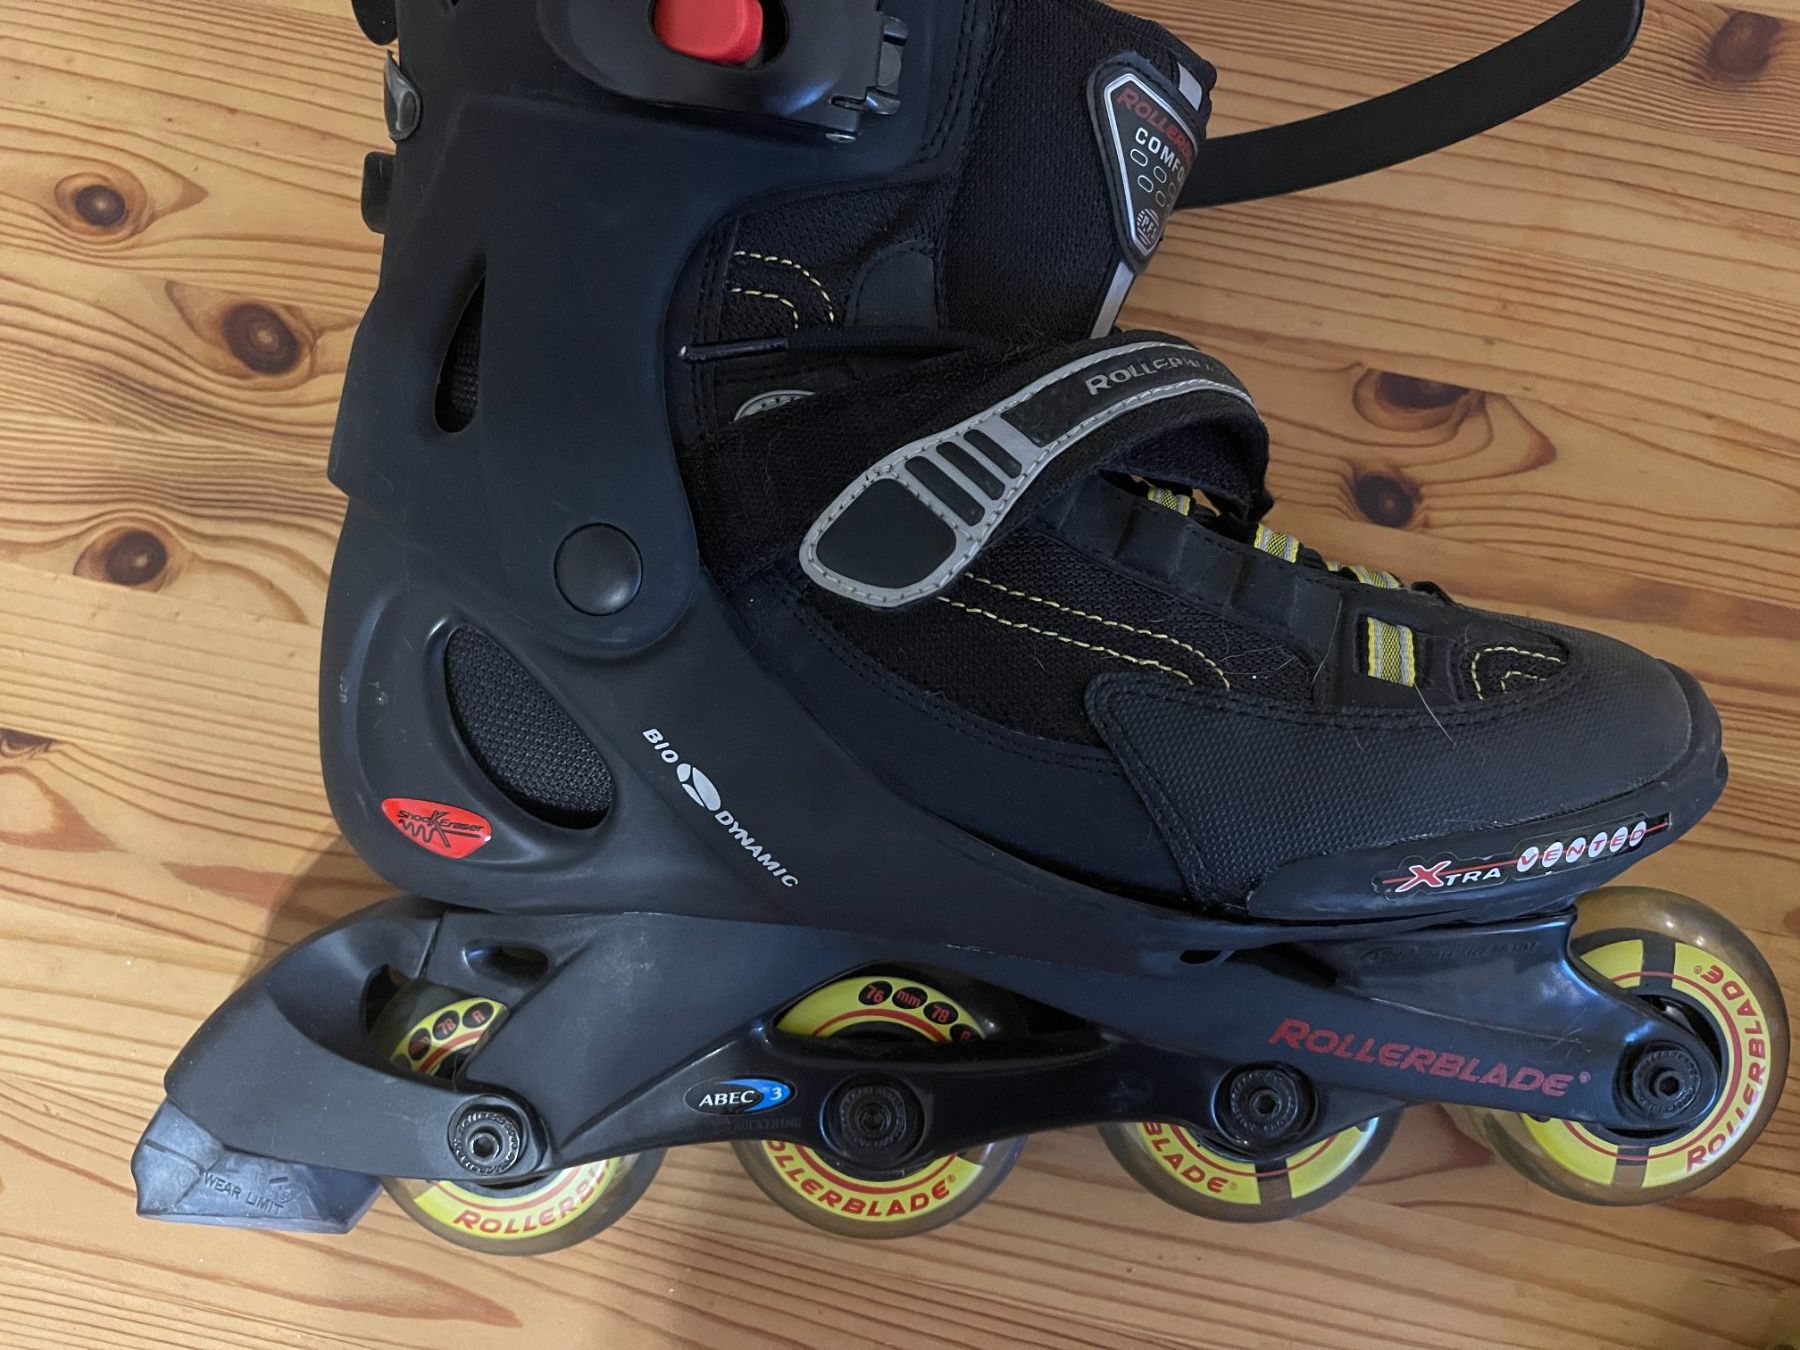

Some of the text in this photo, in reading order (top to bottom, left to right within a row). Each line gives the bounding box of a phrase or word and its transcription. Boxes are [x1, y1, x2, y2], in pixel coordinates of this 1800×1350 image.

[1116, 89, 1193, 162] ROLLERB
[1135, 127, 1185, 182] COMFO
[642, 729, 798, 887] BIO DYNAMIC
[1395, 823, 1646, 892] XTRA VENTED
[437, 1018, 457, 1035] 78
[866, 985, 884, 1003] 76
[896, 991, 921, 1007] mm
[932, 1005, 949, 1023] 78
[699, 1086, 783, 1107] ABEC 3
[204, 1172, 283, 1215] WEAR LIMIT
